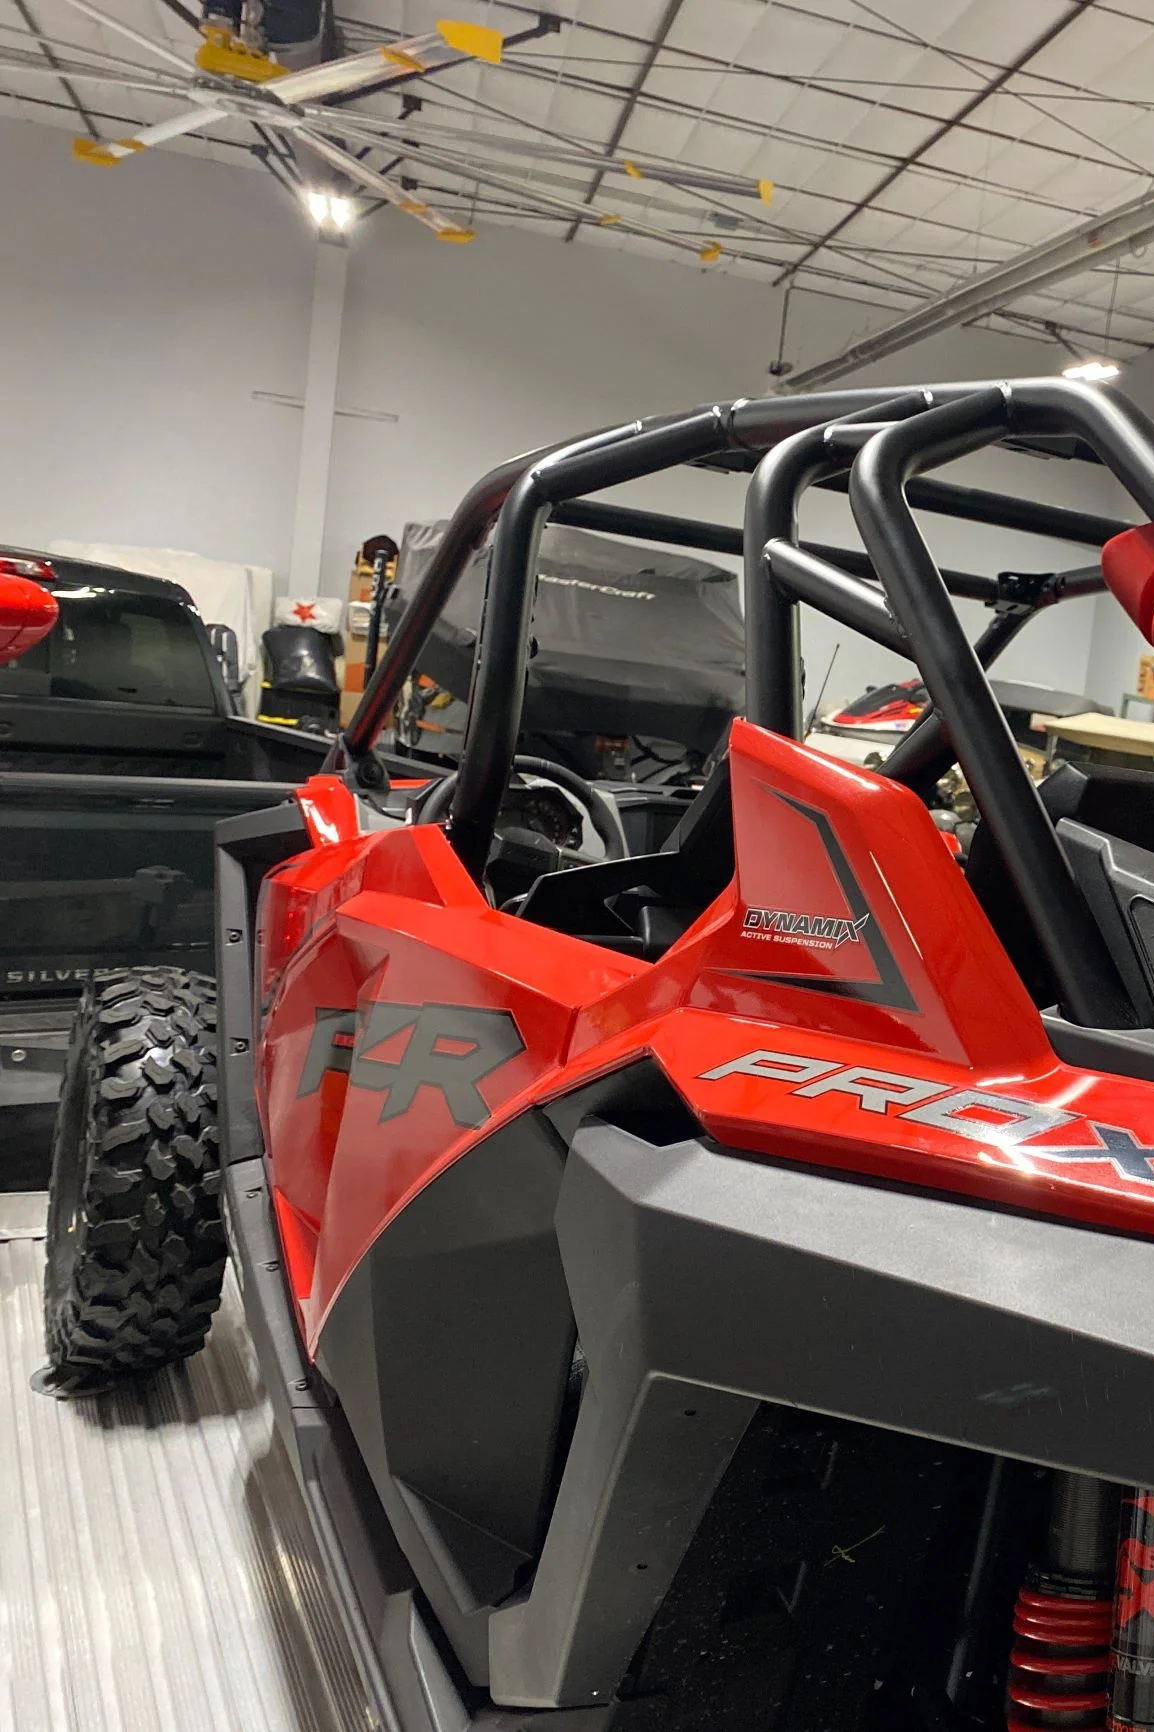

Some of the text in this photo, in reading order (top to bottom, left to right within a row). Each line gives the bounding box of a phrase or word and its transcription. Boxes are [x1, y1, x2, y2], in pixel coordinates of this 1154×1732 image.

[740, 930, 833, 949] ACTIVE SUSPENSION
[742, 908, 870, 949] DYNAMIX
[696, 1049, 1086, 1148] PRO
